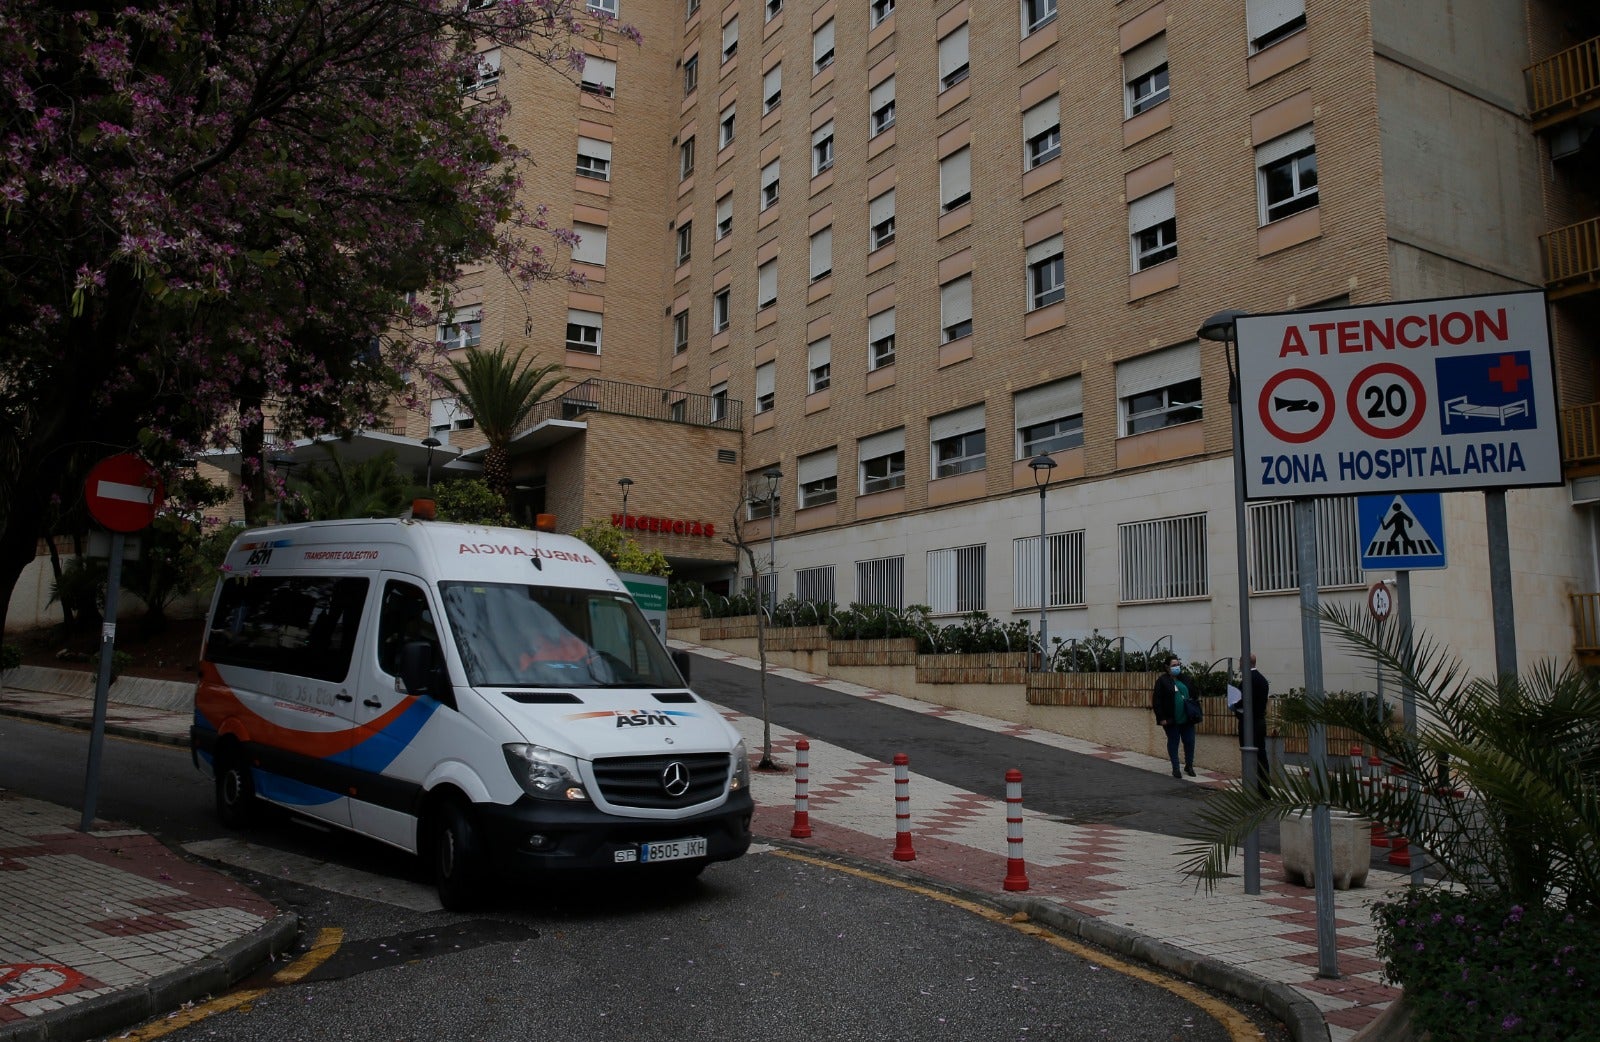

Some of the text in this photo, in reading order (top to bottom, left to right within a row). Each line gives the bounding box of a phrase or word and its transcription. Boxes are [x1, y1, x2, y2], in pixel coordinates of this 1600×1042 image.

[1278, 308, 1509, 358] ATENCION
[1364, 384, 1407, 419] 20
[1261, 442, 1526, 485] ZONA HOSPITALARIA
[611, 514, 715, 537] URGENCIAS
[246, 549, 273, 566] ASM
[304, 551, 379, 560] TRANSPORTE COLECTIVO
[616, 714, 677, 728] ASM
[615, 851, 636, 862] SP
[649, 841, 706, 860] 8505 JKH
